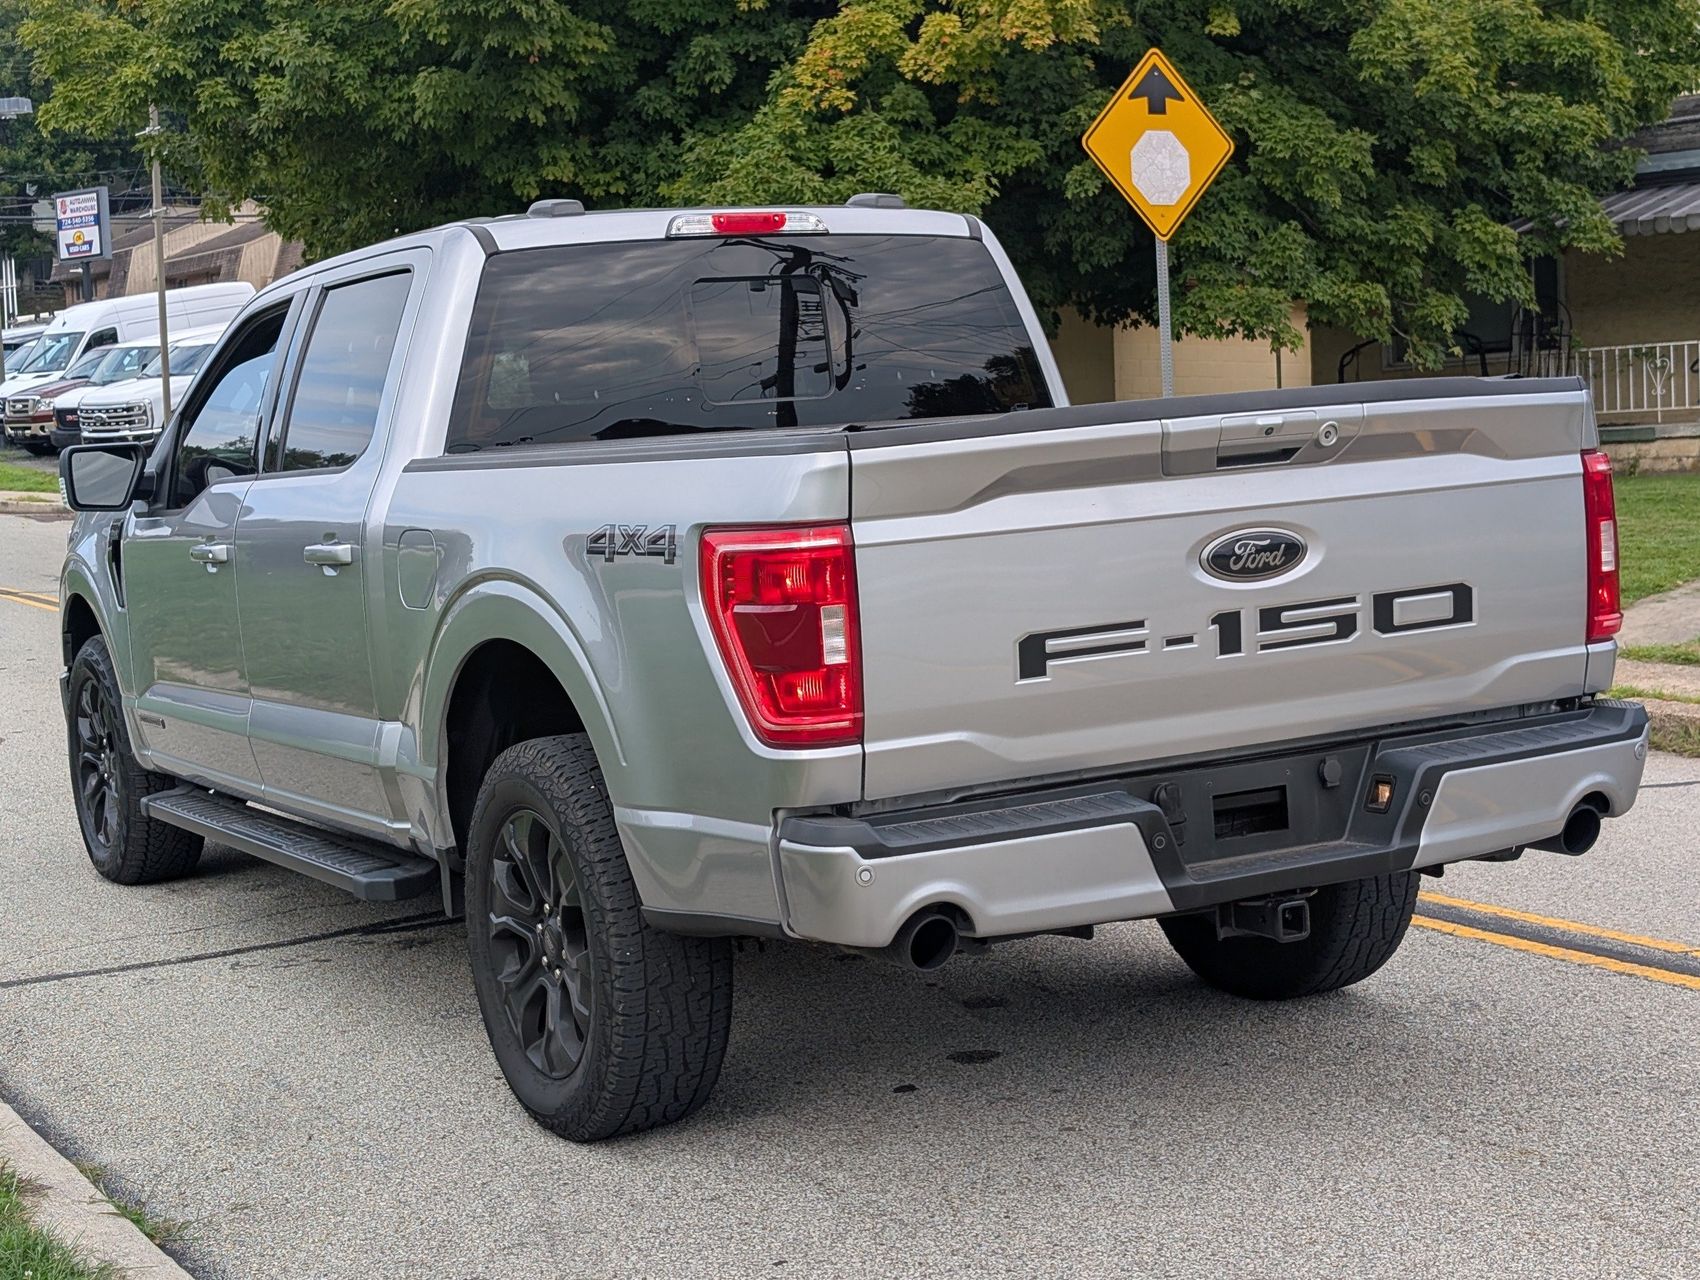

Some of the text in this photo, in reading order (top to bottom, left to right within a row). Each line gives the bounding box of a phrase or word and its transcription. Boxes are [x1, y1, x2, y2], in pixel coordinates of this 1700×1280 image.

[69, 204, 96, 213] WAREHOUSE
[80, 244, 90, 252] CARS
[1229, 539, 1286, 570] Ford
[1016, 581, 1476, 682] F-150
